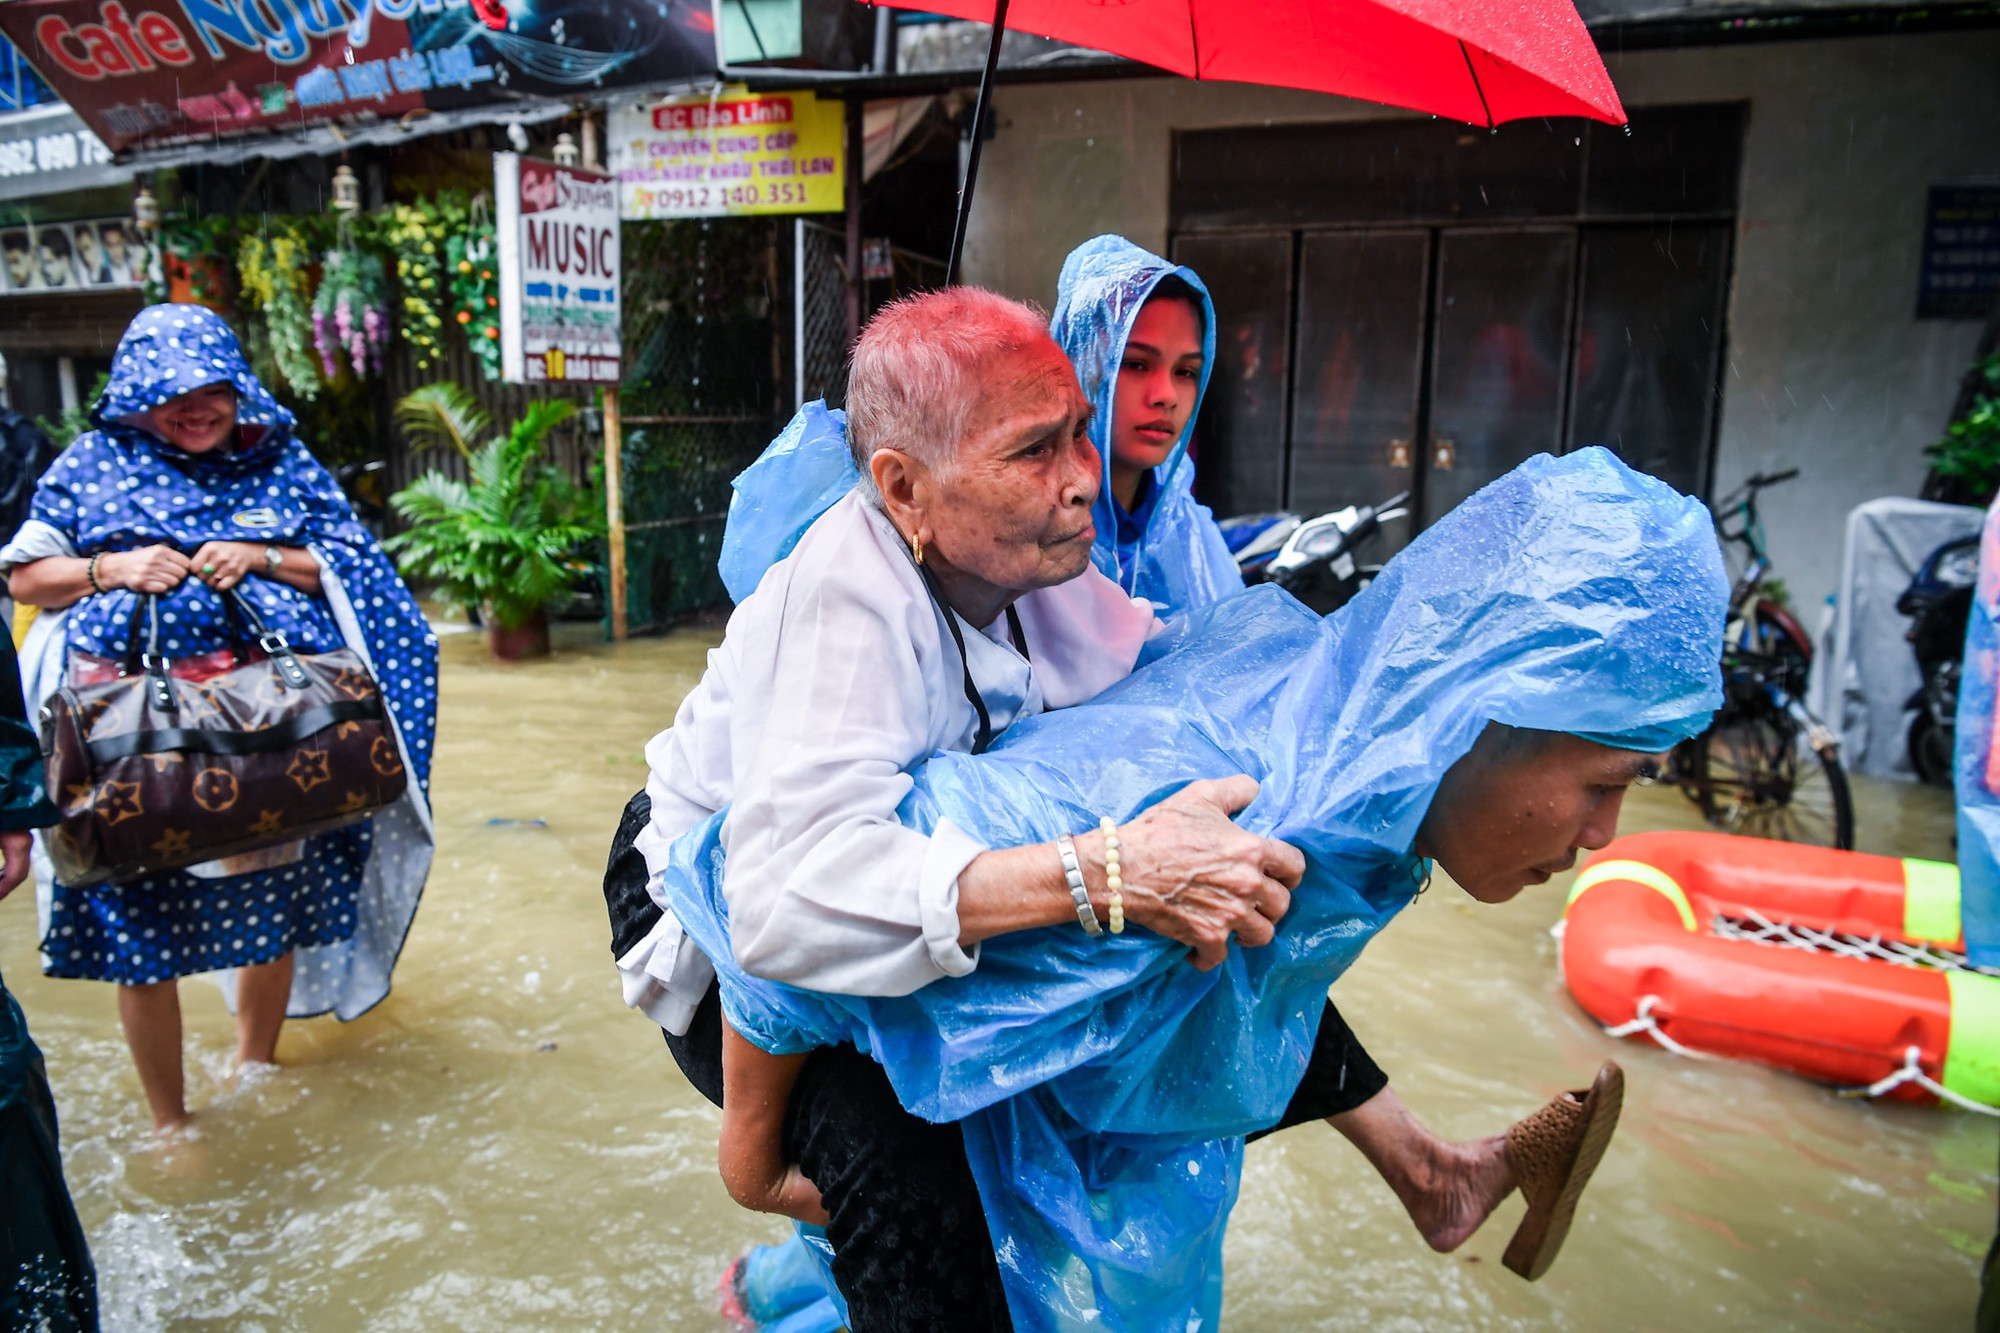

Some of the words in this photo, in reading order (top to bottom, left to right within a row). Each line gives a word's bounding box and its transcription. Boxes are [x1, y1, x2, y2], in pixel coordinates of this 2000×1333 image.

[36, 0, 195, 81] Cafe
[736, 102, 786, 124] Linh
[800, 157, 834, 176] LAN
[658, 187, 709, 208] 0912
[720, 183, 807, 206] 140.351
[528, 219, 614, 278] MUSIC
